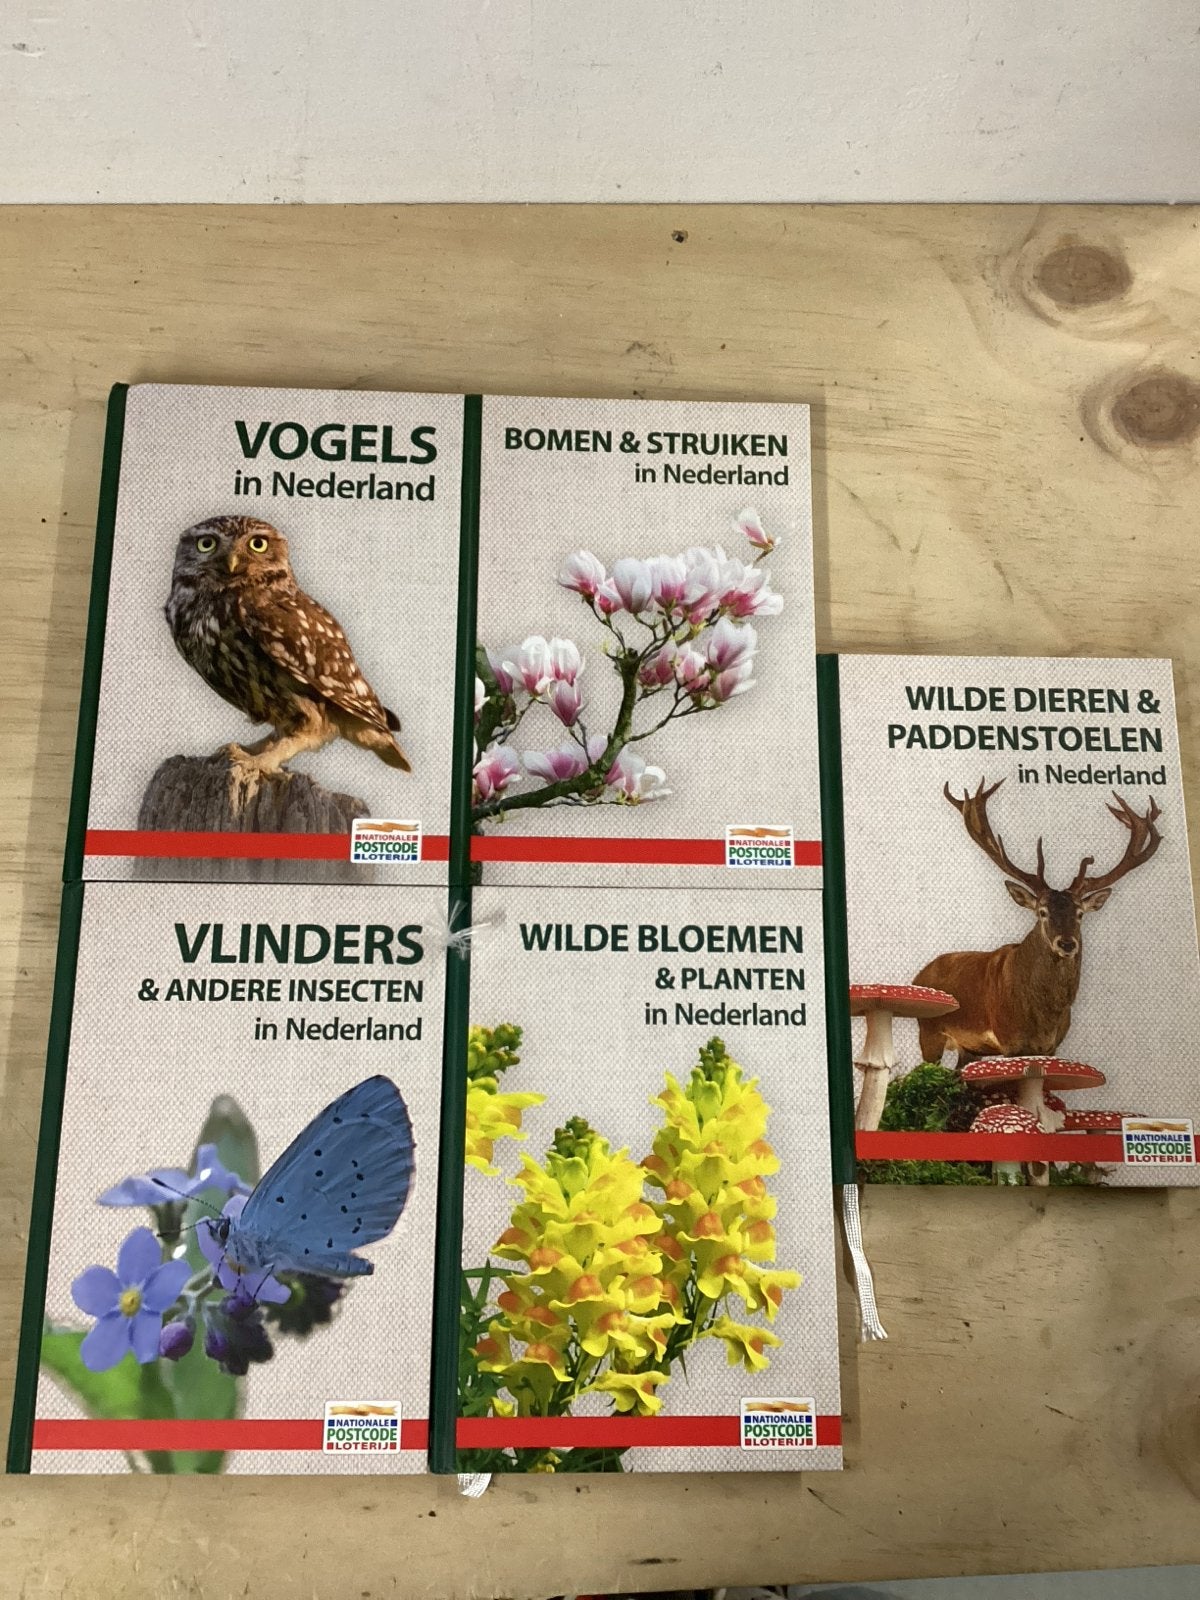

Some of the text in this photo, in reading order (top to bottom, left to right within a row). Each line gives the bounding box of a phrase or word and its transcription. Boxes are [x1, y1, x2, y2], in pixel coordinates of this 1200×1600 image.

[235, 421, 437, 464] VOGELS
[505, 428, 787, 456] BOMEN & STRUIKEN
[235, 470, 435, 501] in Nederland
[636, 463, 788, 485] in Nederland
[905, 686, 1161, 714] WILDE DIEREN &
[888, 724, 1162, 752] PADDENSTOELEN
[1019, 764, 1166, 785] in Nederland
[355, 842, 417, 853] POSTCODE
[729, 847, 790, 858] POSTCODE
[175, 923, 424, 965] VLINDERS
[520, 924, 803, 953] WILDE BLOEMEN
[138, 978, 423, 1002] & ANDERE INSECTEN
[655, 967, 805, 990] & PLANTEN
[646, 1002, 806, 1026] in Nederland
[255, 1017, 422, 1040] in Nederland
[1127, 1143, 1191, 1154] POSTCODE
[327, 1428, 397, 1441] POSTCODE
[744, 1425, 813, 1437] POSTCODE
[753, 1438, 804, 1446] LOTERIJ
[336, 1442, 388, 1450] LOTERIJ
